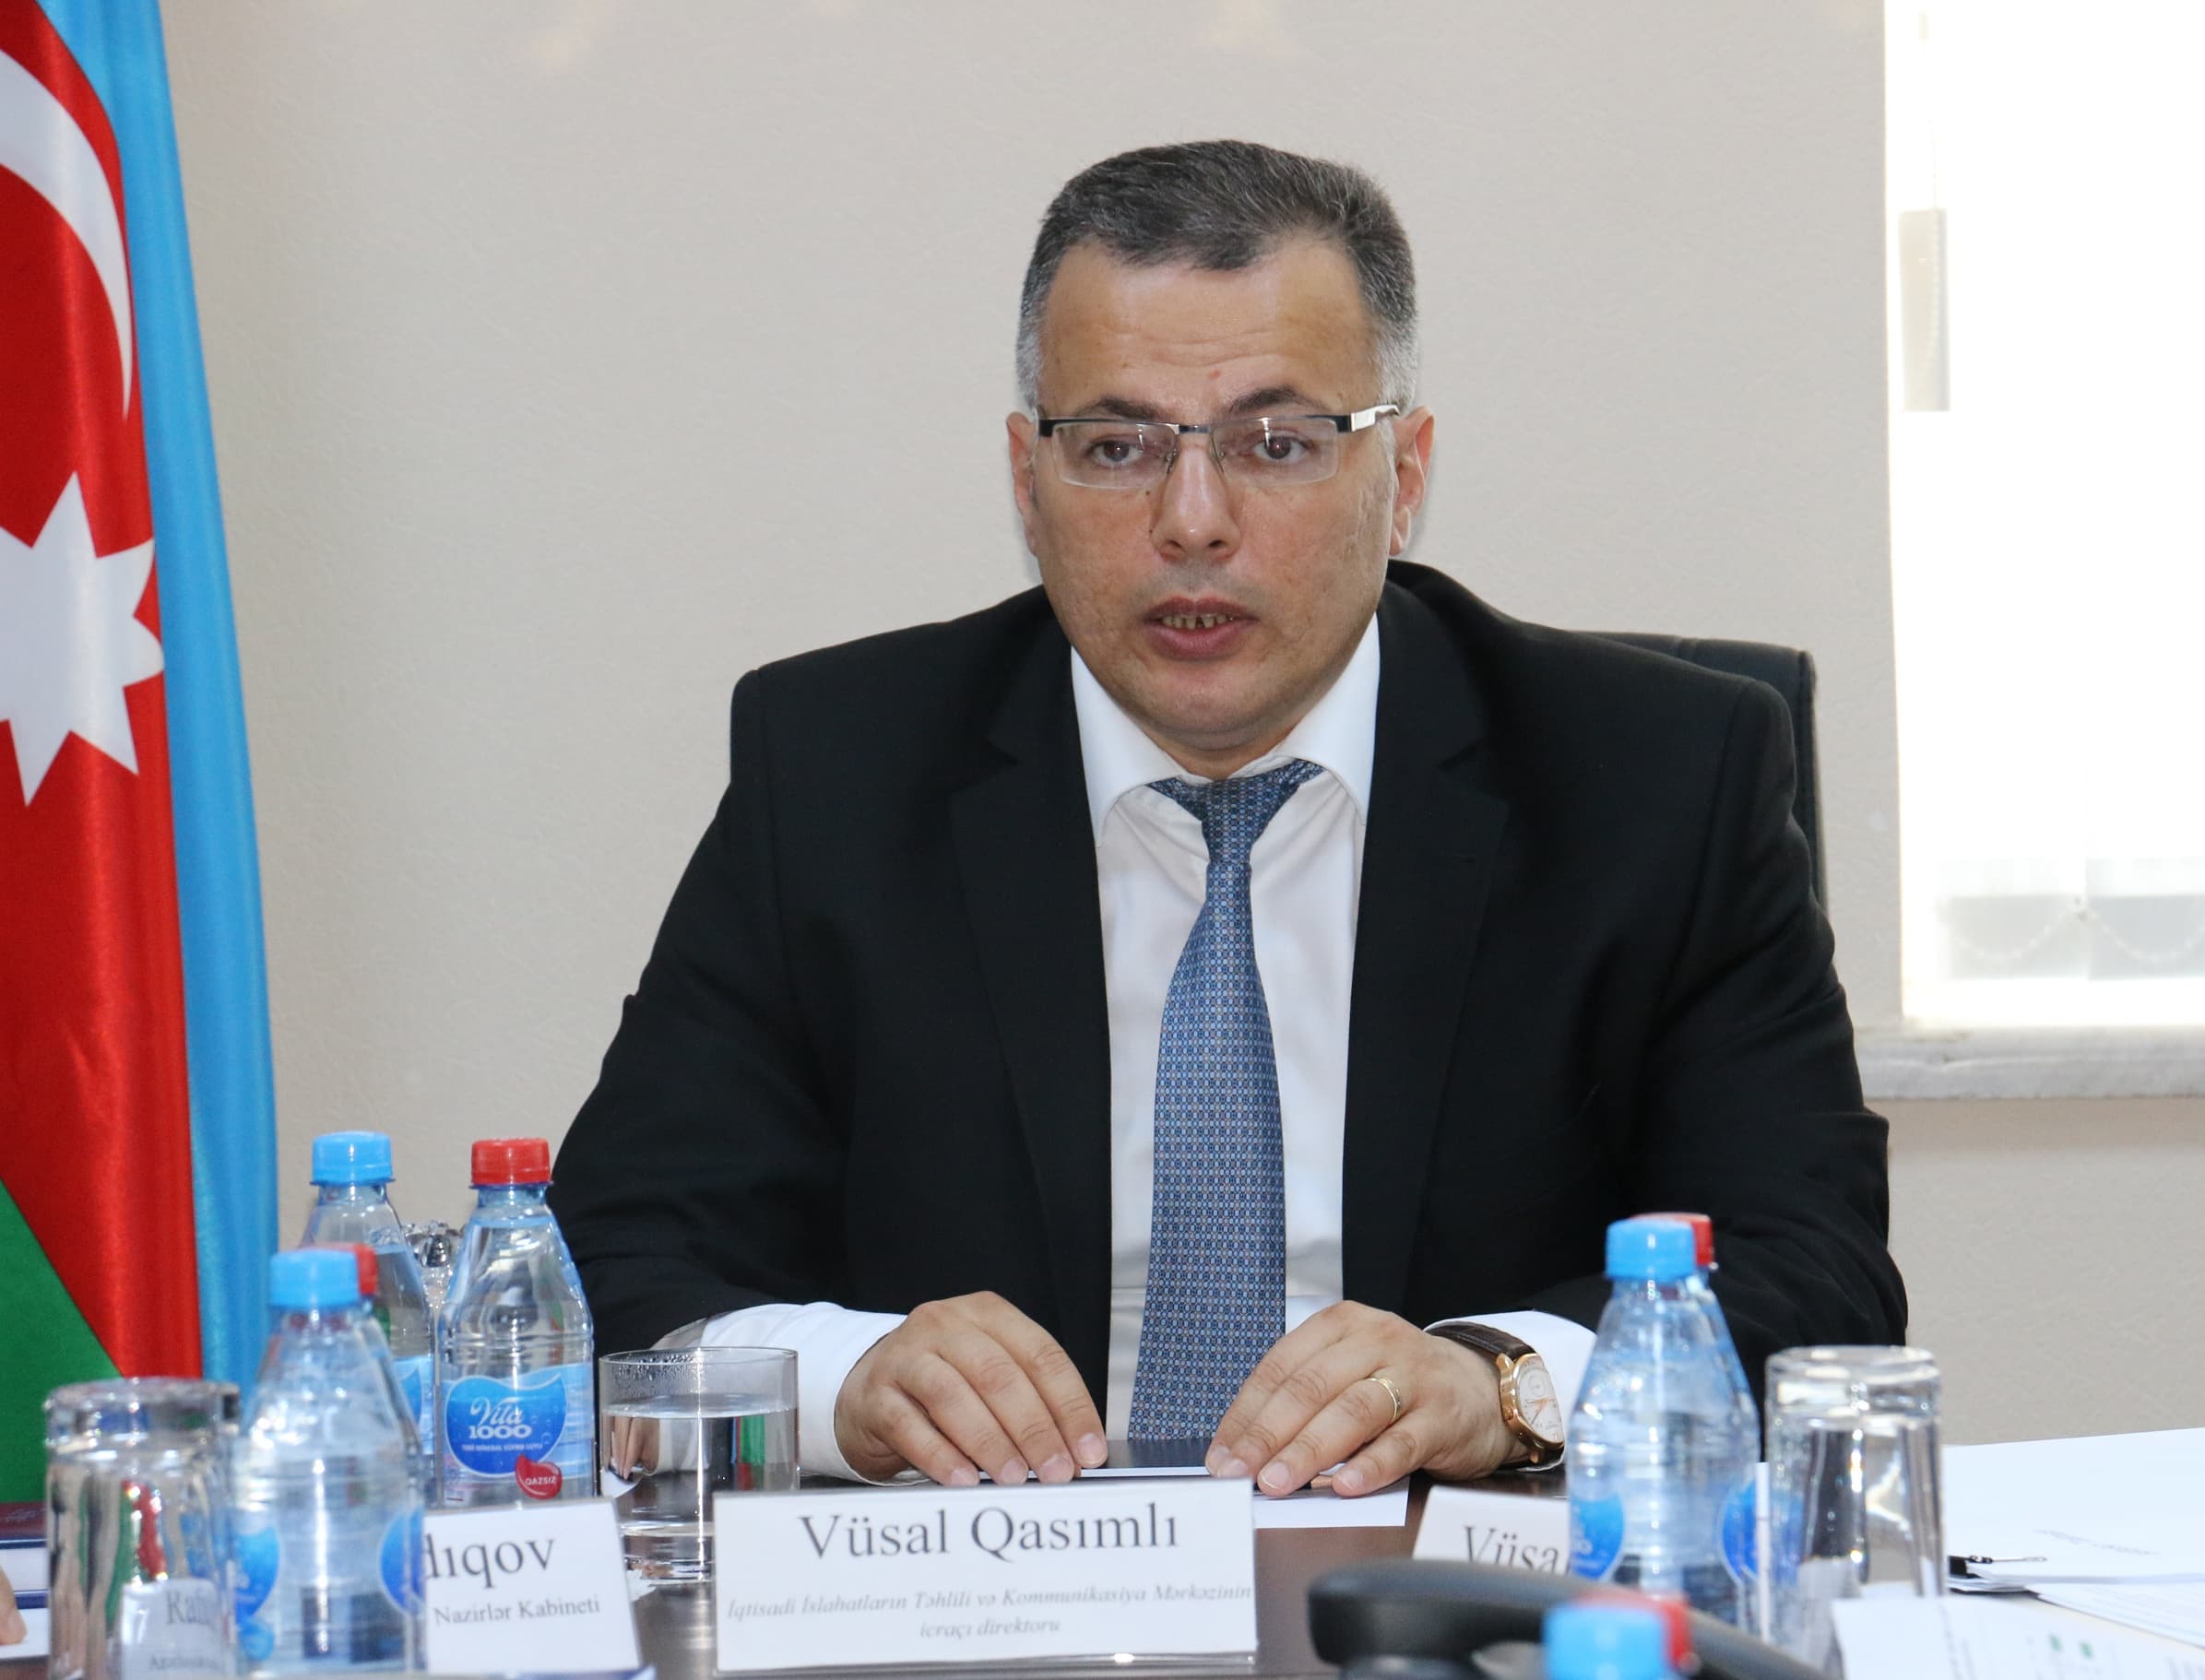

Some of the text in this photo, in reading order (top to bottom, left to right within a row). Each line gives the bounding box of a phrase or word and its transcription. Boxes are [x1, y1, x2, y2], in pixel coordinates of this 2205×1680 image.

[468, 1425, 532, 1439] 1000
[524, 1475, 557, 1485] QAZSIZ
[798, 1502, 1180, 1563] Vüsal Qasımlı
[915, 1591, 972, 1610] Təhlili
[976, 1593, 999, 1608] və
[1002, 1586, 1147, 1607] Kommunikasiya
[434, 1593, 601, 1626] Nazirlər Kabineti
[977, 1616, 1061, 1636] direktoru
